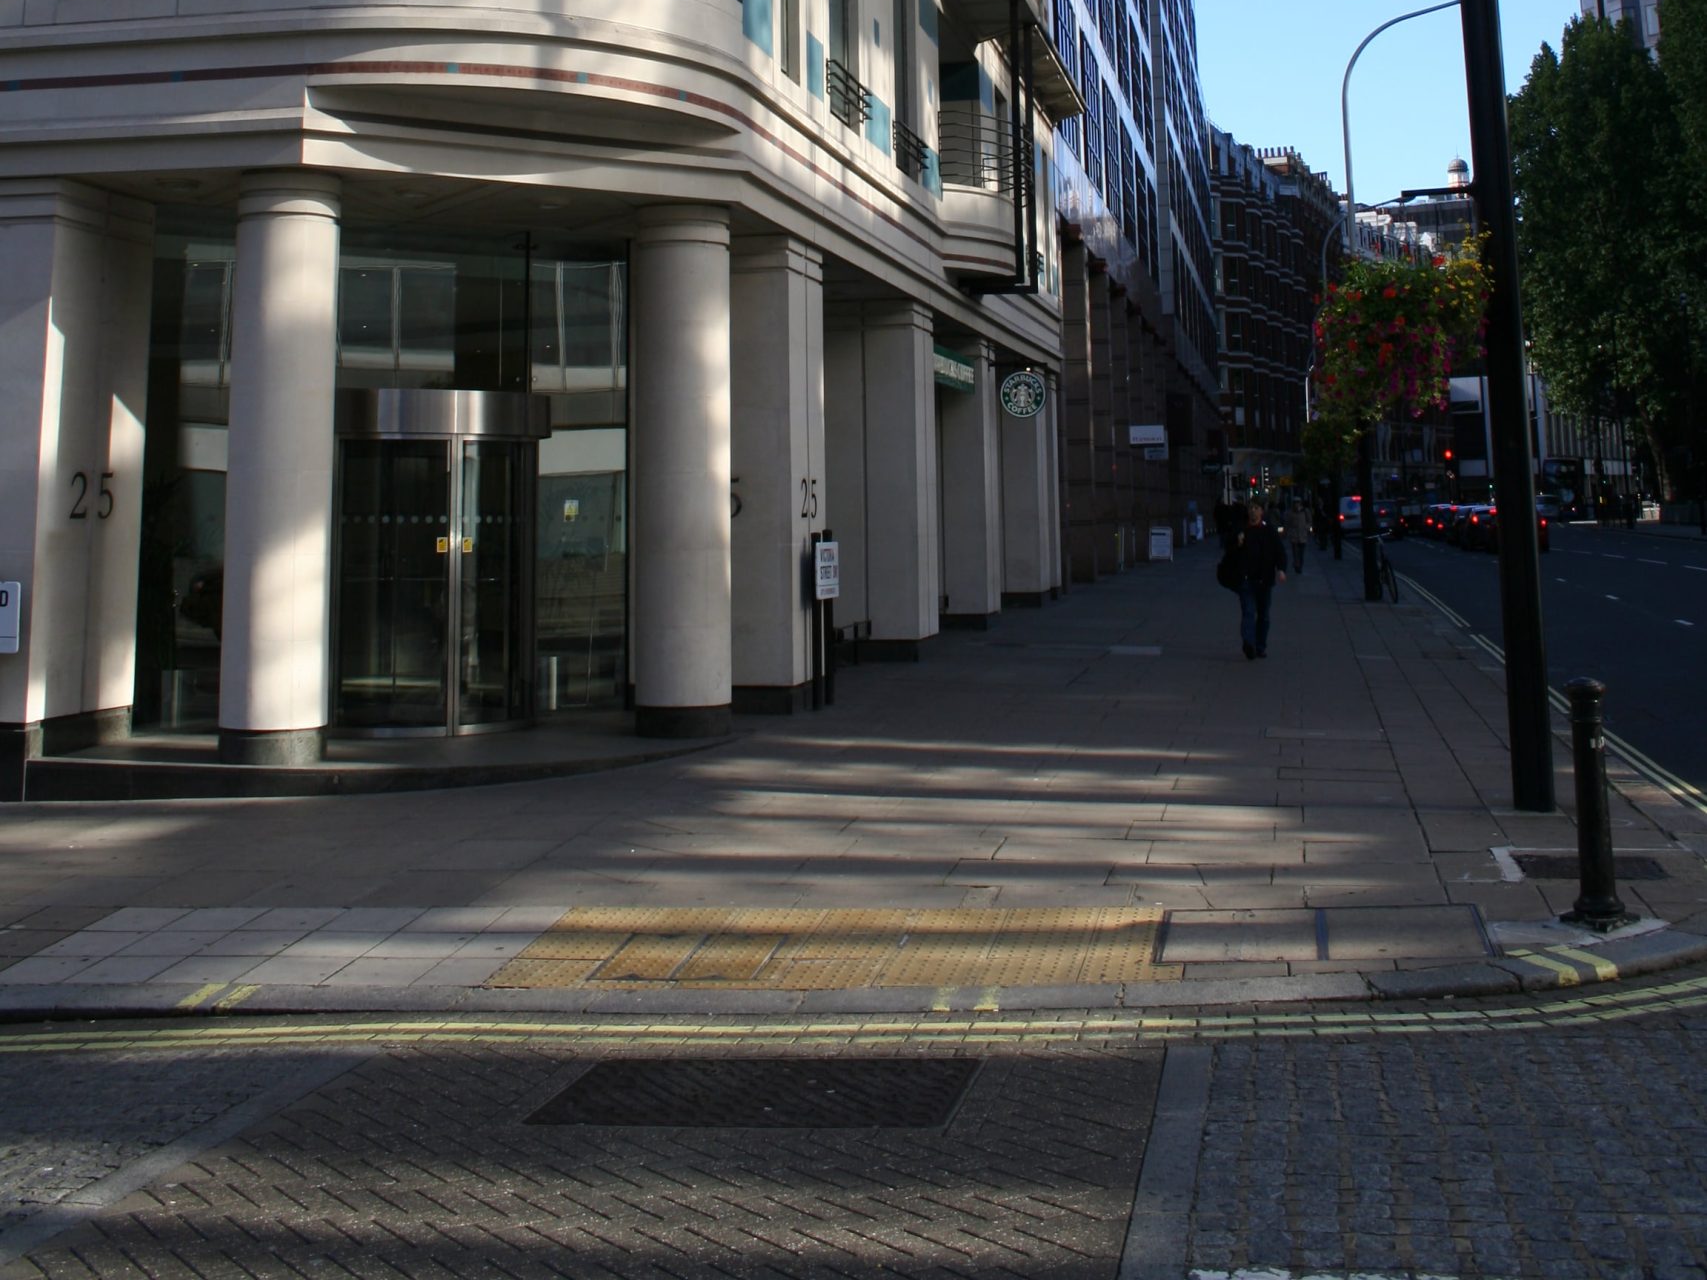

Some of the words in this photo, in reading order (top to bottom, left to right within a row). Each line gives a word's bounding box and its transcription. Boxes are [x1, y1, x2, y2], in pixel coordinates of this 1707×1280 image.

[1003, 374, 1042, 394] STARBUCKS
[1006, 402, 1038, 414] COFFEE
[69, 471, 114, 519] 25
[801, 478, 817, 518] 25
